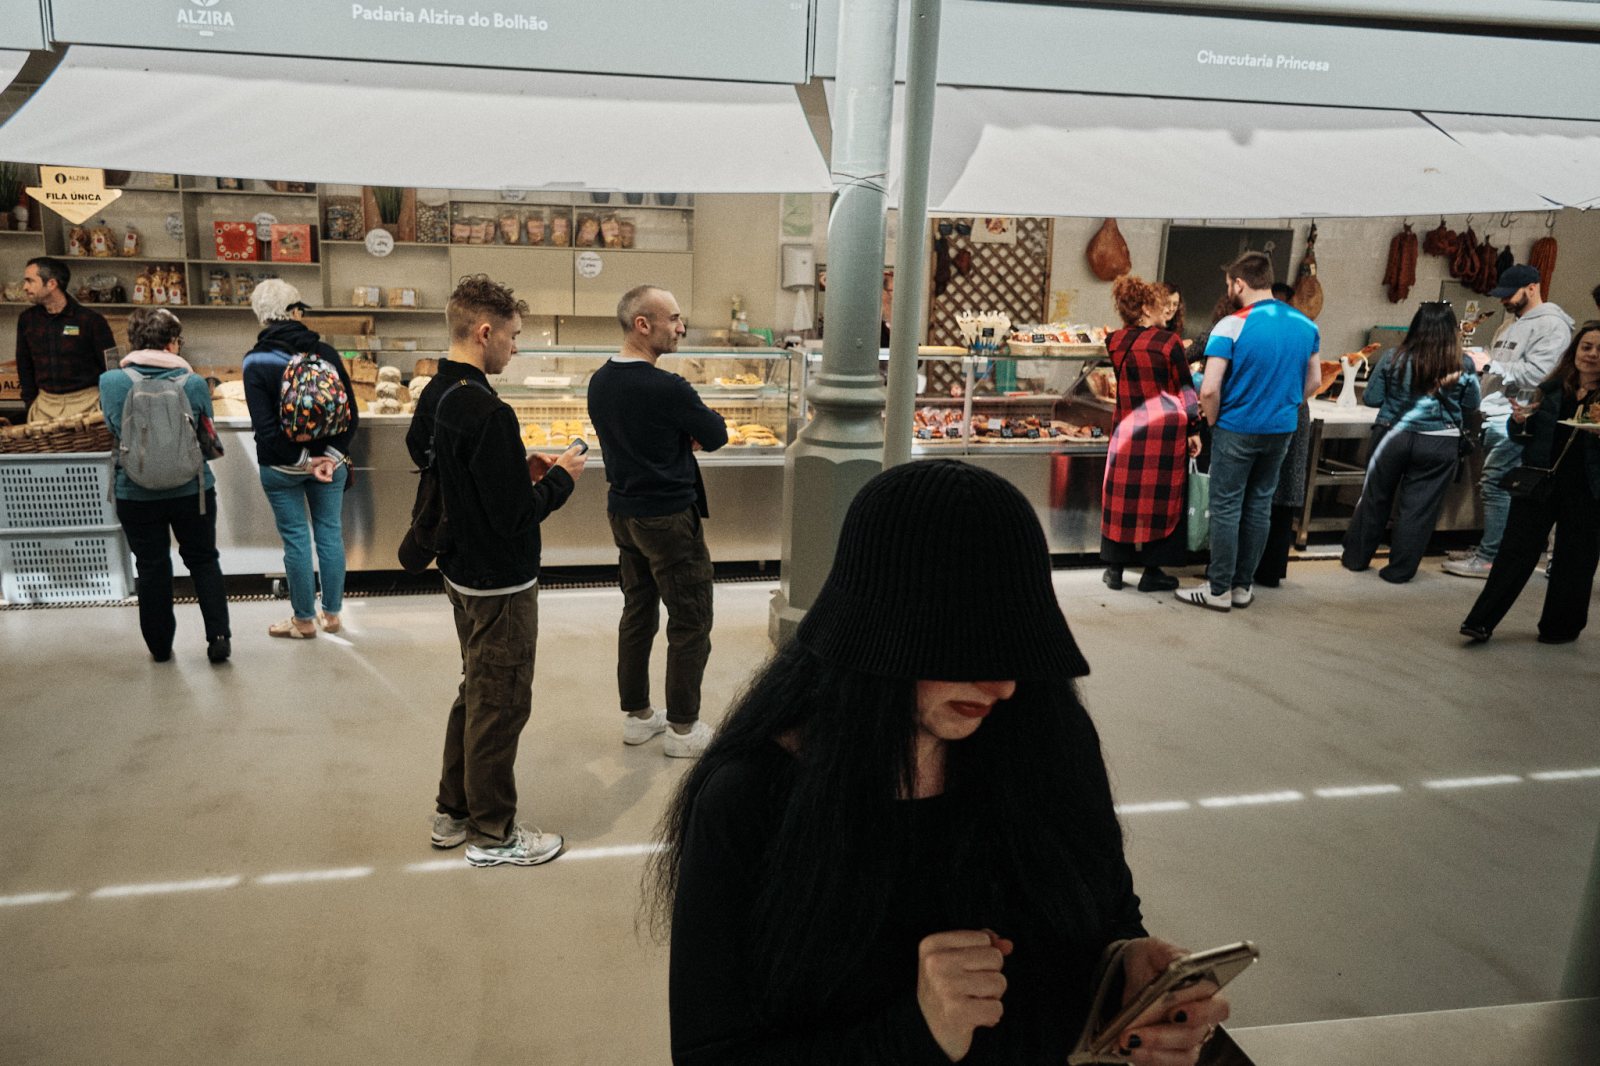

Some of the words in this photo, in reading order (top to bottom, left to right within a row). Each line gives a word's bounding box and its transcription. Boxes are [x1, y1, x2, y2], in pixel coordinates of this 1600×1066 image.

[177, 9, 234, 26] ALZIRA
[352, 3, 414, 23] Padaria
[418, 7, 465, 26] Alzira
[468, 11, 490, 28] do
[493, 12, 549, 31] Bolhão
[1197, 50, 1273, 68] Charcutaria
[1276, 55, 1330, 72] Princesa
[46, 192, 68, 201] FILA
[70, 191, 102, 201] ÚNICA
